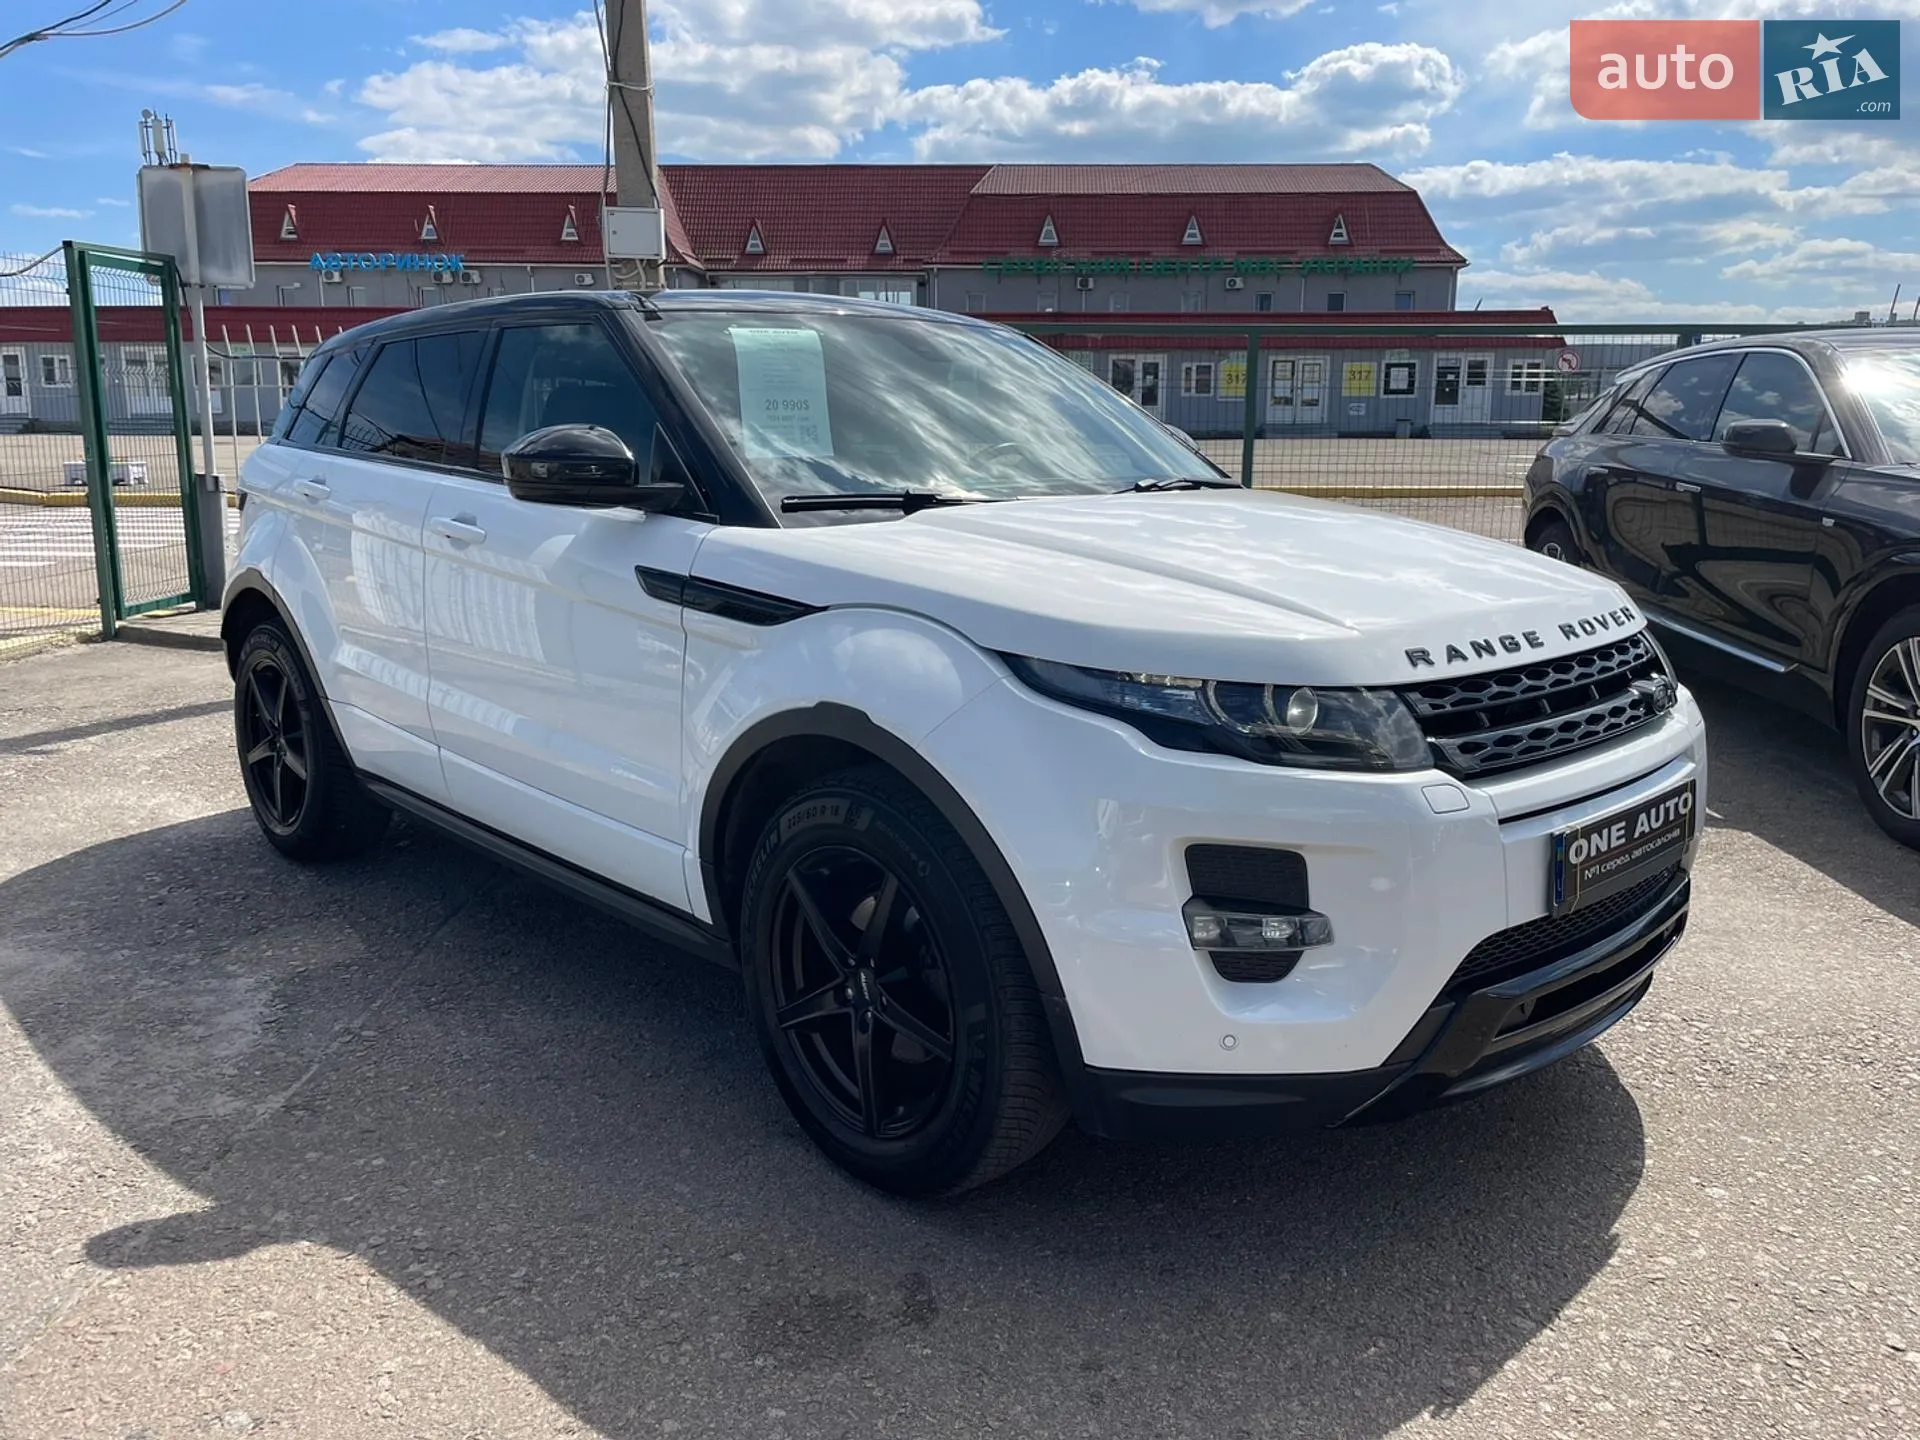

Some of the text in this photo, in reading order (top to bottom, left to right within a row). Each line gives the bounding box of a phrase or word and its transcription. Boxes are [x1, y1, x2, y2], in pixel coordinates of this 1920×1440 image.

[309, 252, 465, 271] АВТОРИНОК
[1138, 257, 1225, 274] ЦЕНТР
[1301, 255, 1415, 274] УКРАЇНИ
[1349, 368, 1371, 381] 317
[765, 398, 810, 411] 20 990$
[1404, 605, 1636, 668] RANGE ROVER
[1569, 792, 1692, 864] ONE AUTO
[1601, 853, 1631, 872] серед
